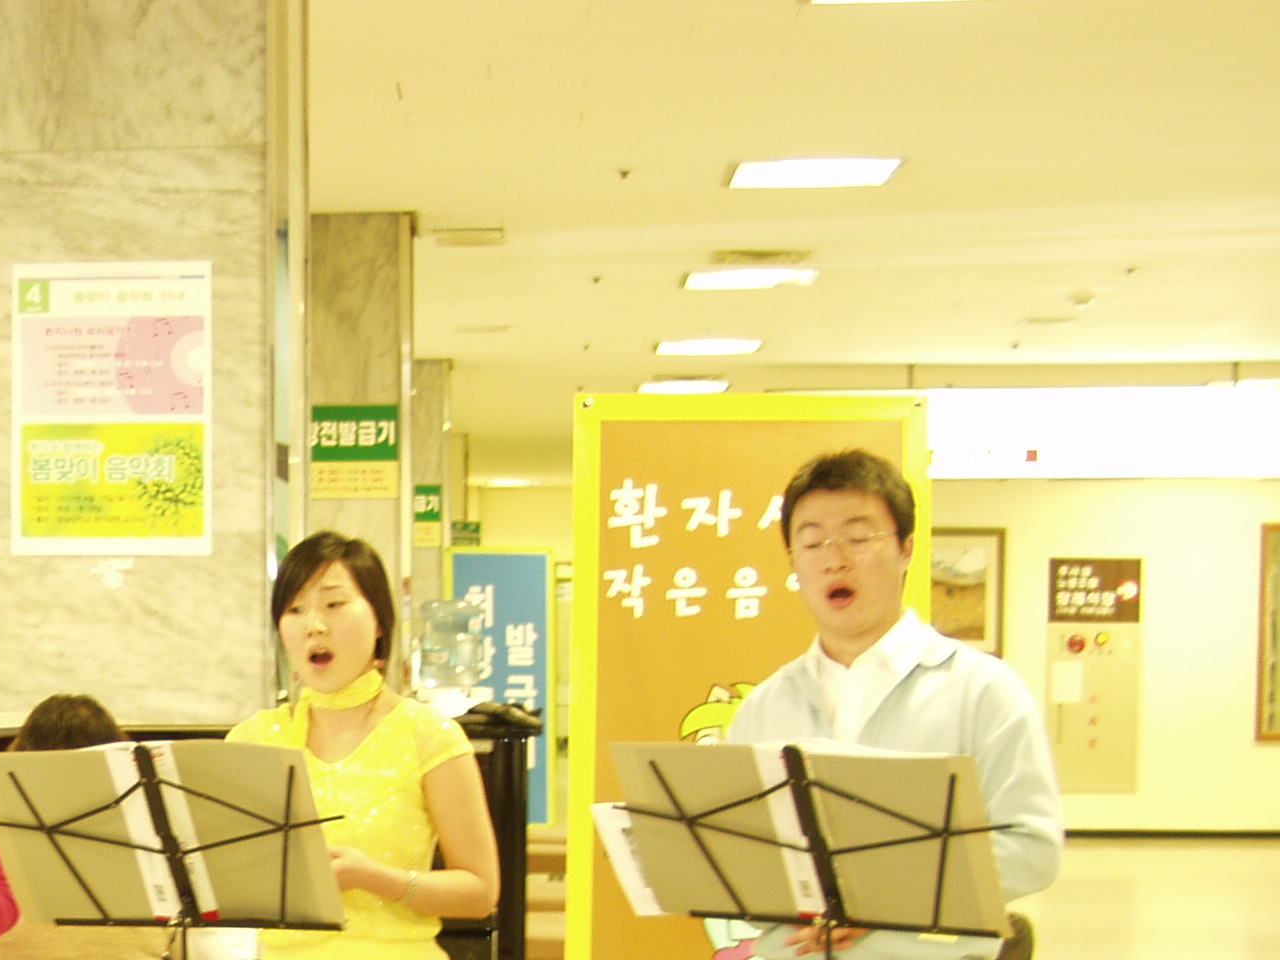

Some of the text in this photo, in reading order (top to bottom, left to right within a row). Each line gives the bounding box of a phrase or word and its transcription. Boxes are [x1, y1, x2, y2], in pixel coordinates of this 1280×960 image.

[26, 283, 42, 304] 4
[30, 455, 173, 482] 봄맞이 음악회
[504, 622, 539, 769] 발급
